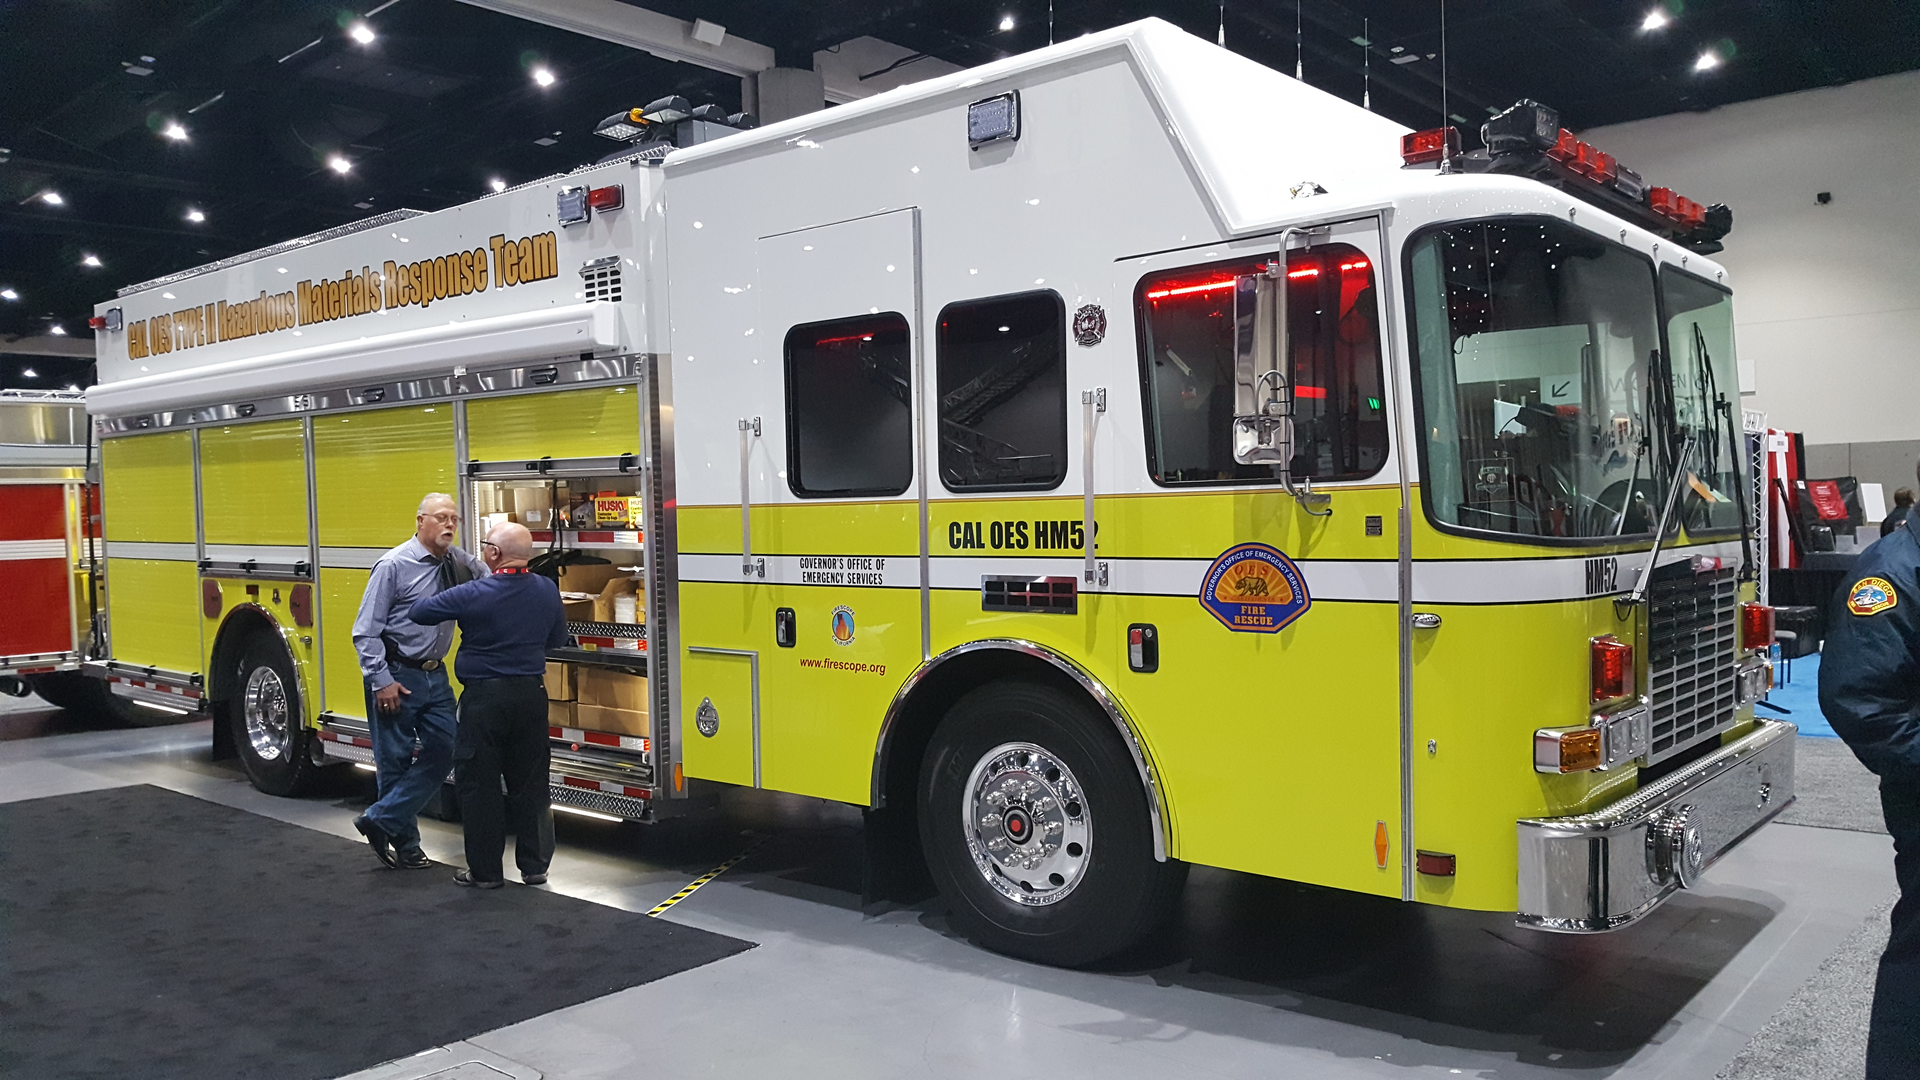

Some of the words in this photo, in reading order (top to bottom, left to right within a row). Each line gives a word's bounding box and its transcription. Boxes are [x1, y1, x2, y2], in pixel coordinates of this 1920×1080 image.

[127, 319, 149, 360] CAL
[151, 313, 172, 356] OES
[173, 306, 204, 351] TYPE
[205, 303, 216, 345] II
[217, 290, 296, 342] Hazardous
[297, 266, 382, 327] Materials
[383, 247, 488, 308] Response
[490, 230, 558, 289] Team
[949, 521, 985, 549] CAL
[990, 521, 1029, 549] OES
[800, 557, 844, 569] GOVERNOR'S
[847, 558, 872, 570] OFFICE
[876, 559, 885, 571] OF
[802, 571, 844, 584] EMERGENCY
[847, 572, 883, 585] SERVICES
[1205, 563, 1226, 601] GOVERNOR'S
[1225, 551, 1244, 566] OFFICE
[1254, 550, 1289, 574] EMERGENCY
[1287, 572, 1303, 604] SERVICES
[1585, 557, 1617, 595] HM52
[1853, 580, 1868, 594] SAN
[1871, 579, 1893, 597] DIEGO
[831, 604, 855, 616] FIRESCOPE
[1241, 605, 1266, 615] FIRE
[1234, 615, 1273, 626] RESCUE
[831, 634, 856, 647] CALIFORNIA
[800, 658, 886, 676] www.firescope.org
